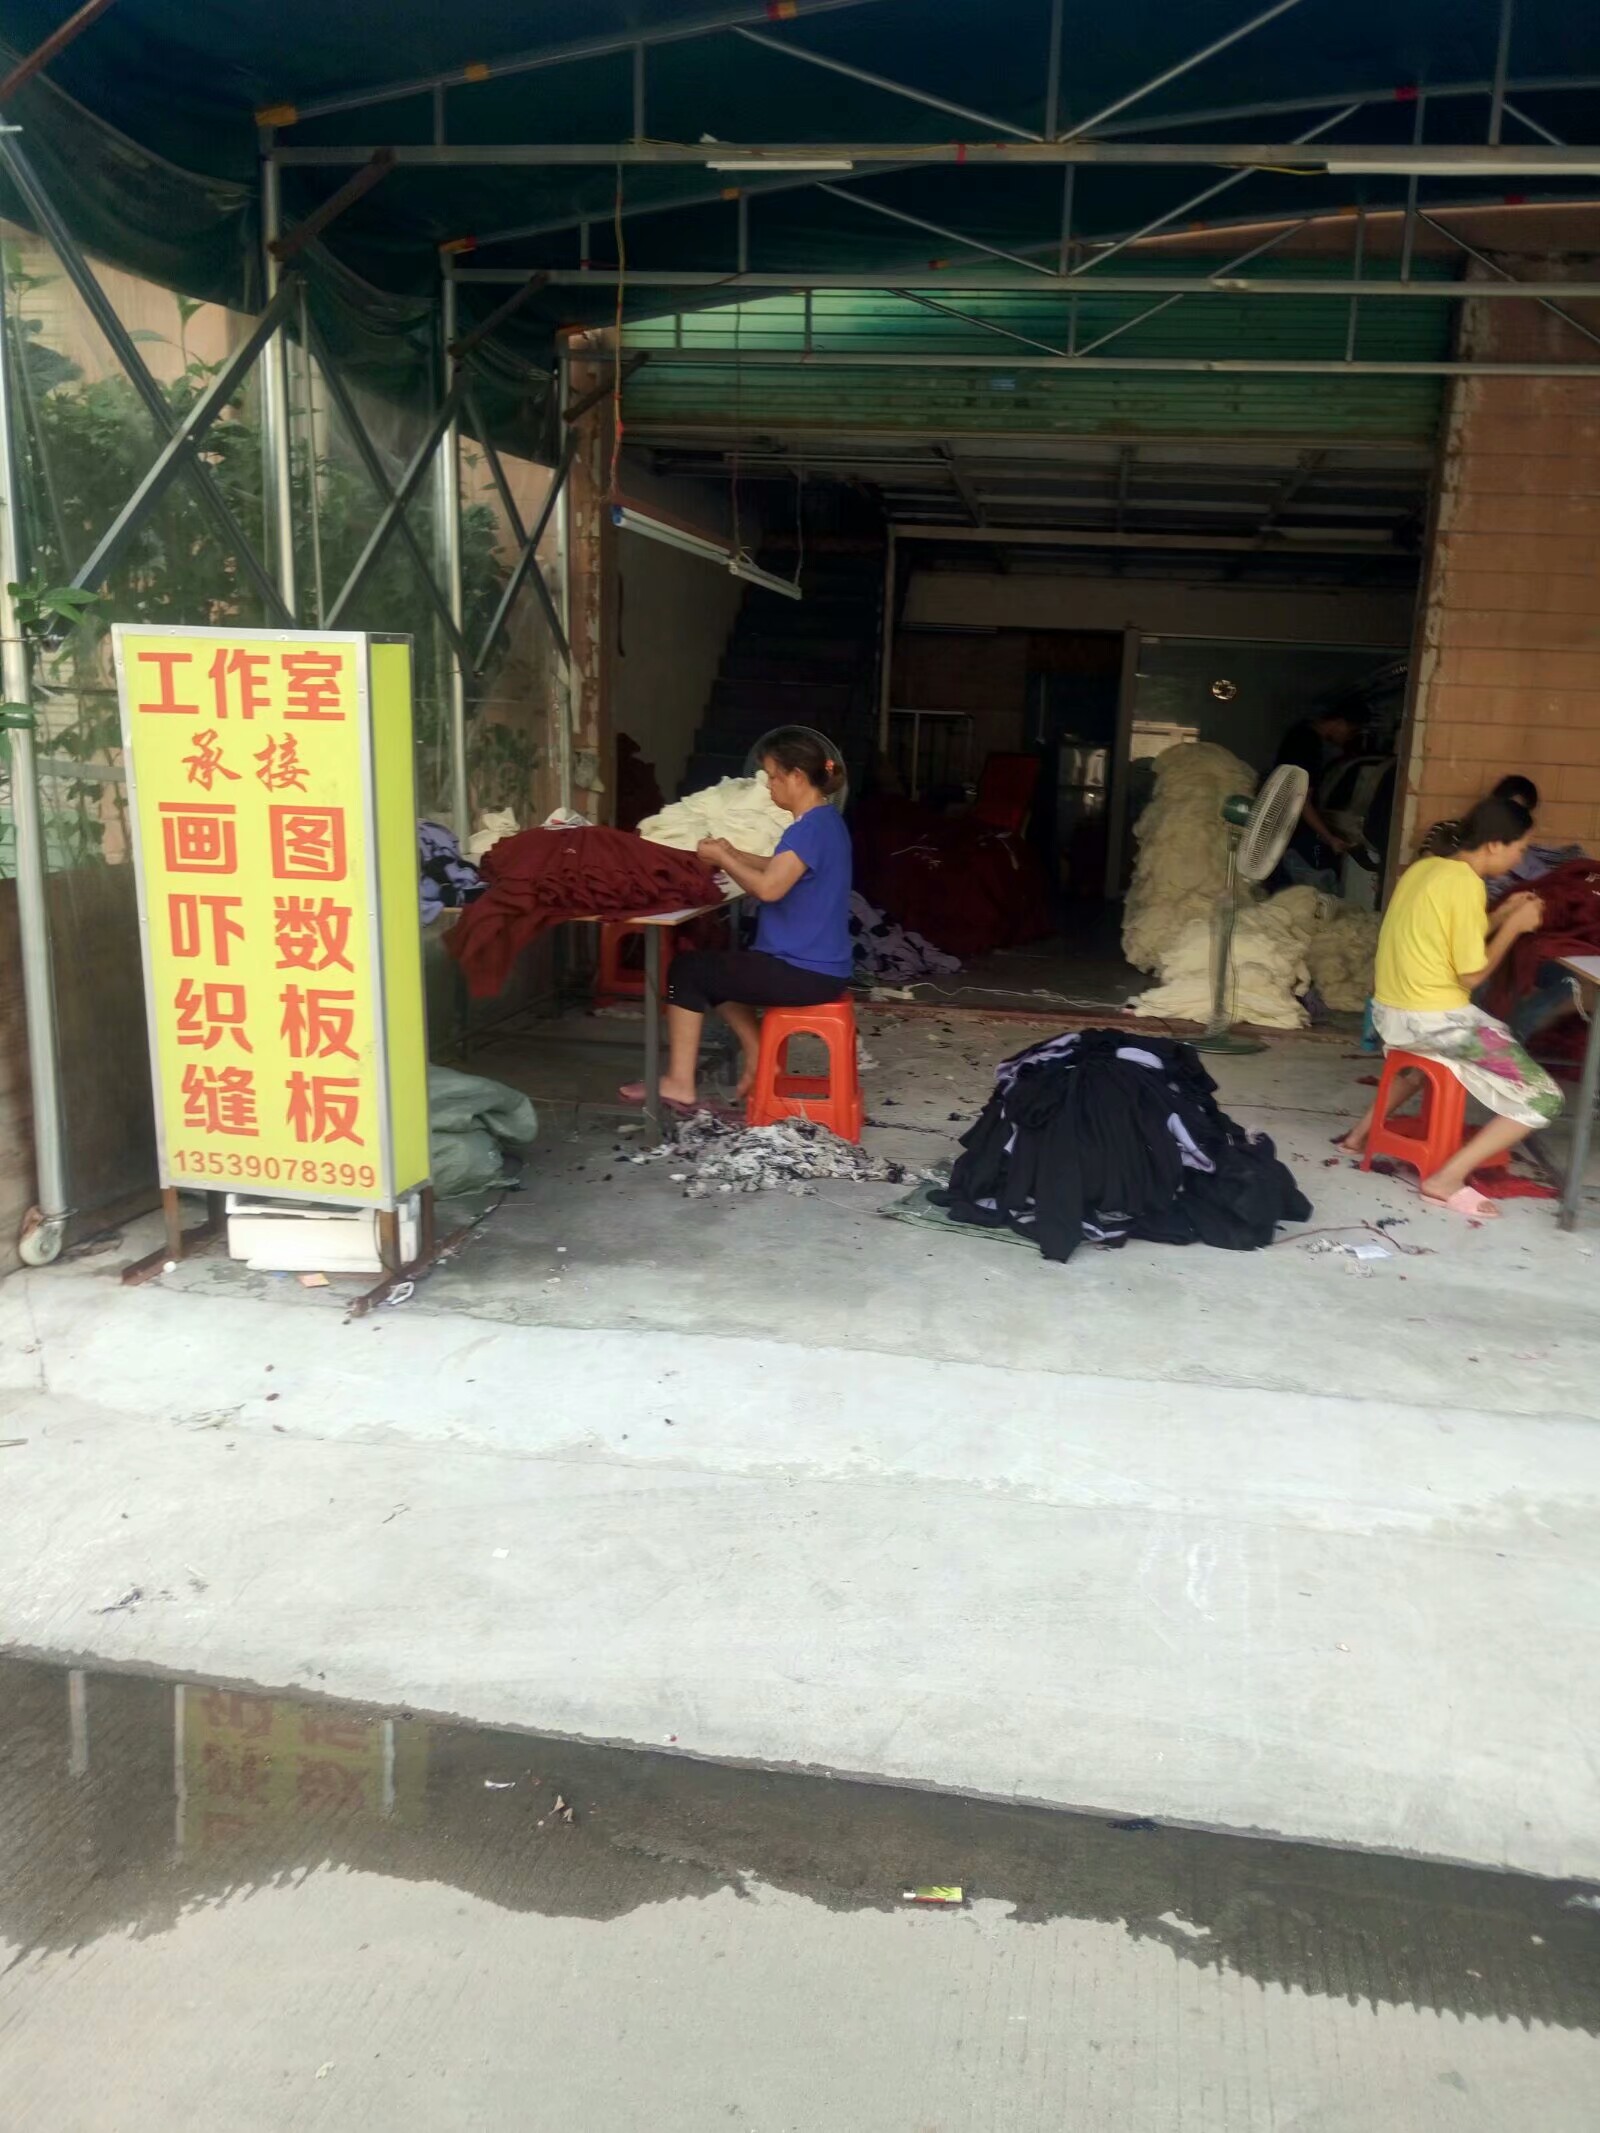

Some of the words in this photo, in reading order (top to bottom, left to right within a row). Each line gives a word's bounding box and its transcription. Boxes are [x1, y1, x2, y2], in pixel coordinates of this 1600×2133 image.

[138, 648, 346, 720] 工作室
[182, 729, 309, 791] 承接
[159, 802, 348, 881] 画图
[168, 893, 354, 972] 吓数
[175, 978, 361, 1060] 织板
[181, 1064, 365, 1146] 缝板
[174, 1150, 375, 1188] 13539078399
